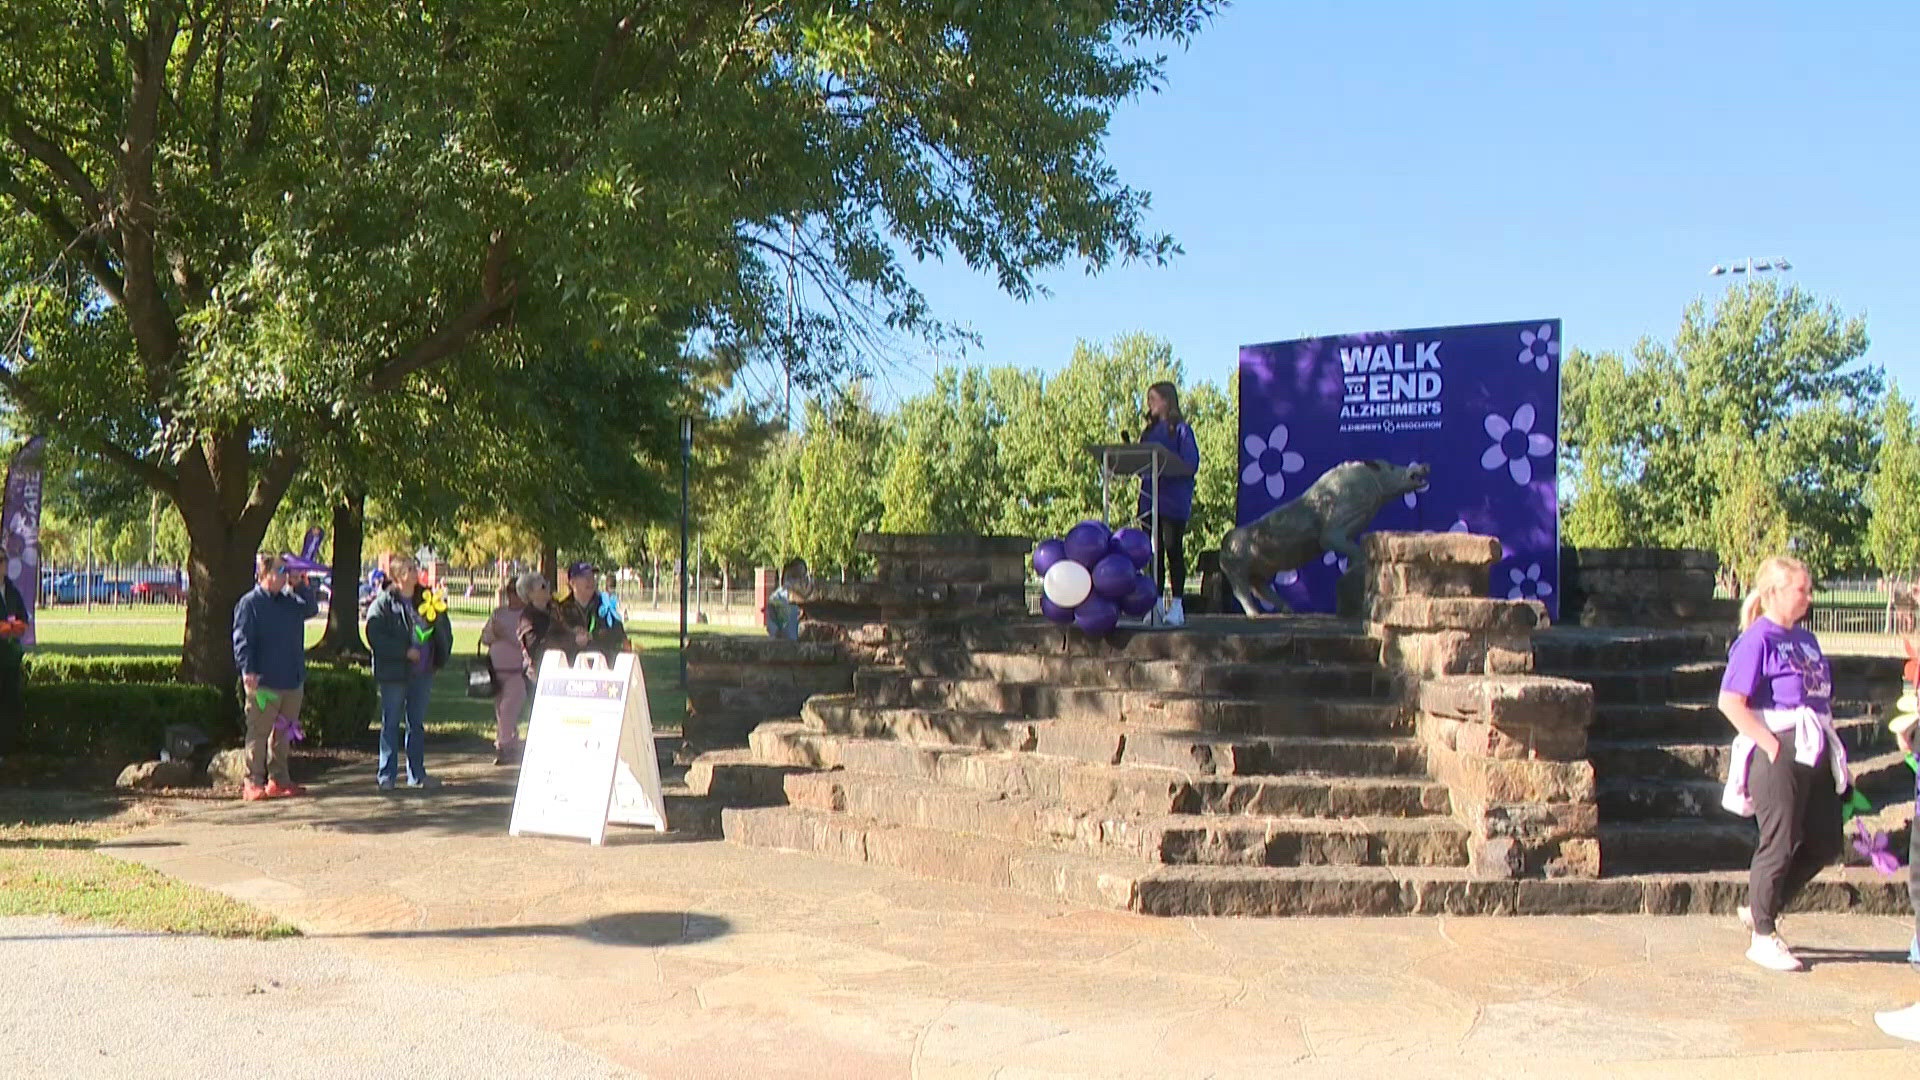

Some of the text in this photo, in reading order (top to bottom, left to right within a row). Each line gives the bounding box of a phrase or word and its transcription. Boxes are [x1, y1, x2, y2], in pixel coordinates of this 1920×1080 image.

[1340, 341, 1442, 373] WALK
[1347, 372, 1442, 401] TO END
[1340, 401, 1442, 418] ALZHEIMER'S
[1396, 420, 1442, 431] ASSOCIATION
